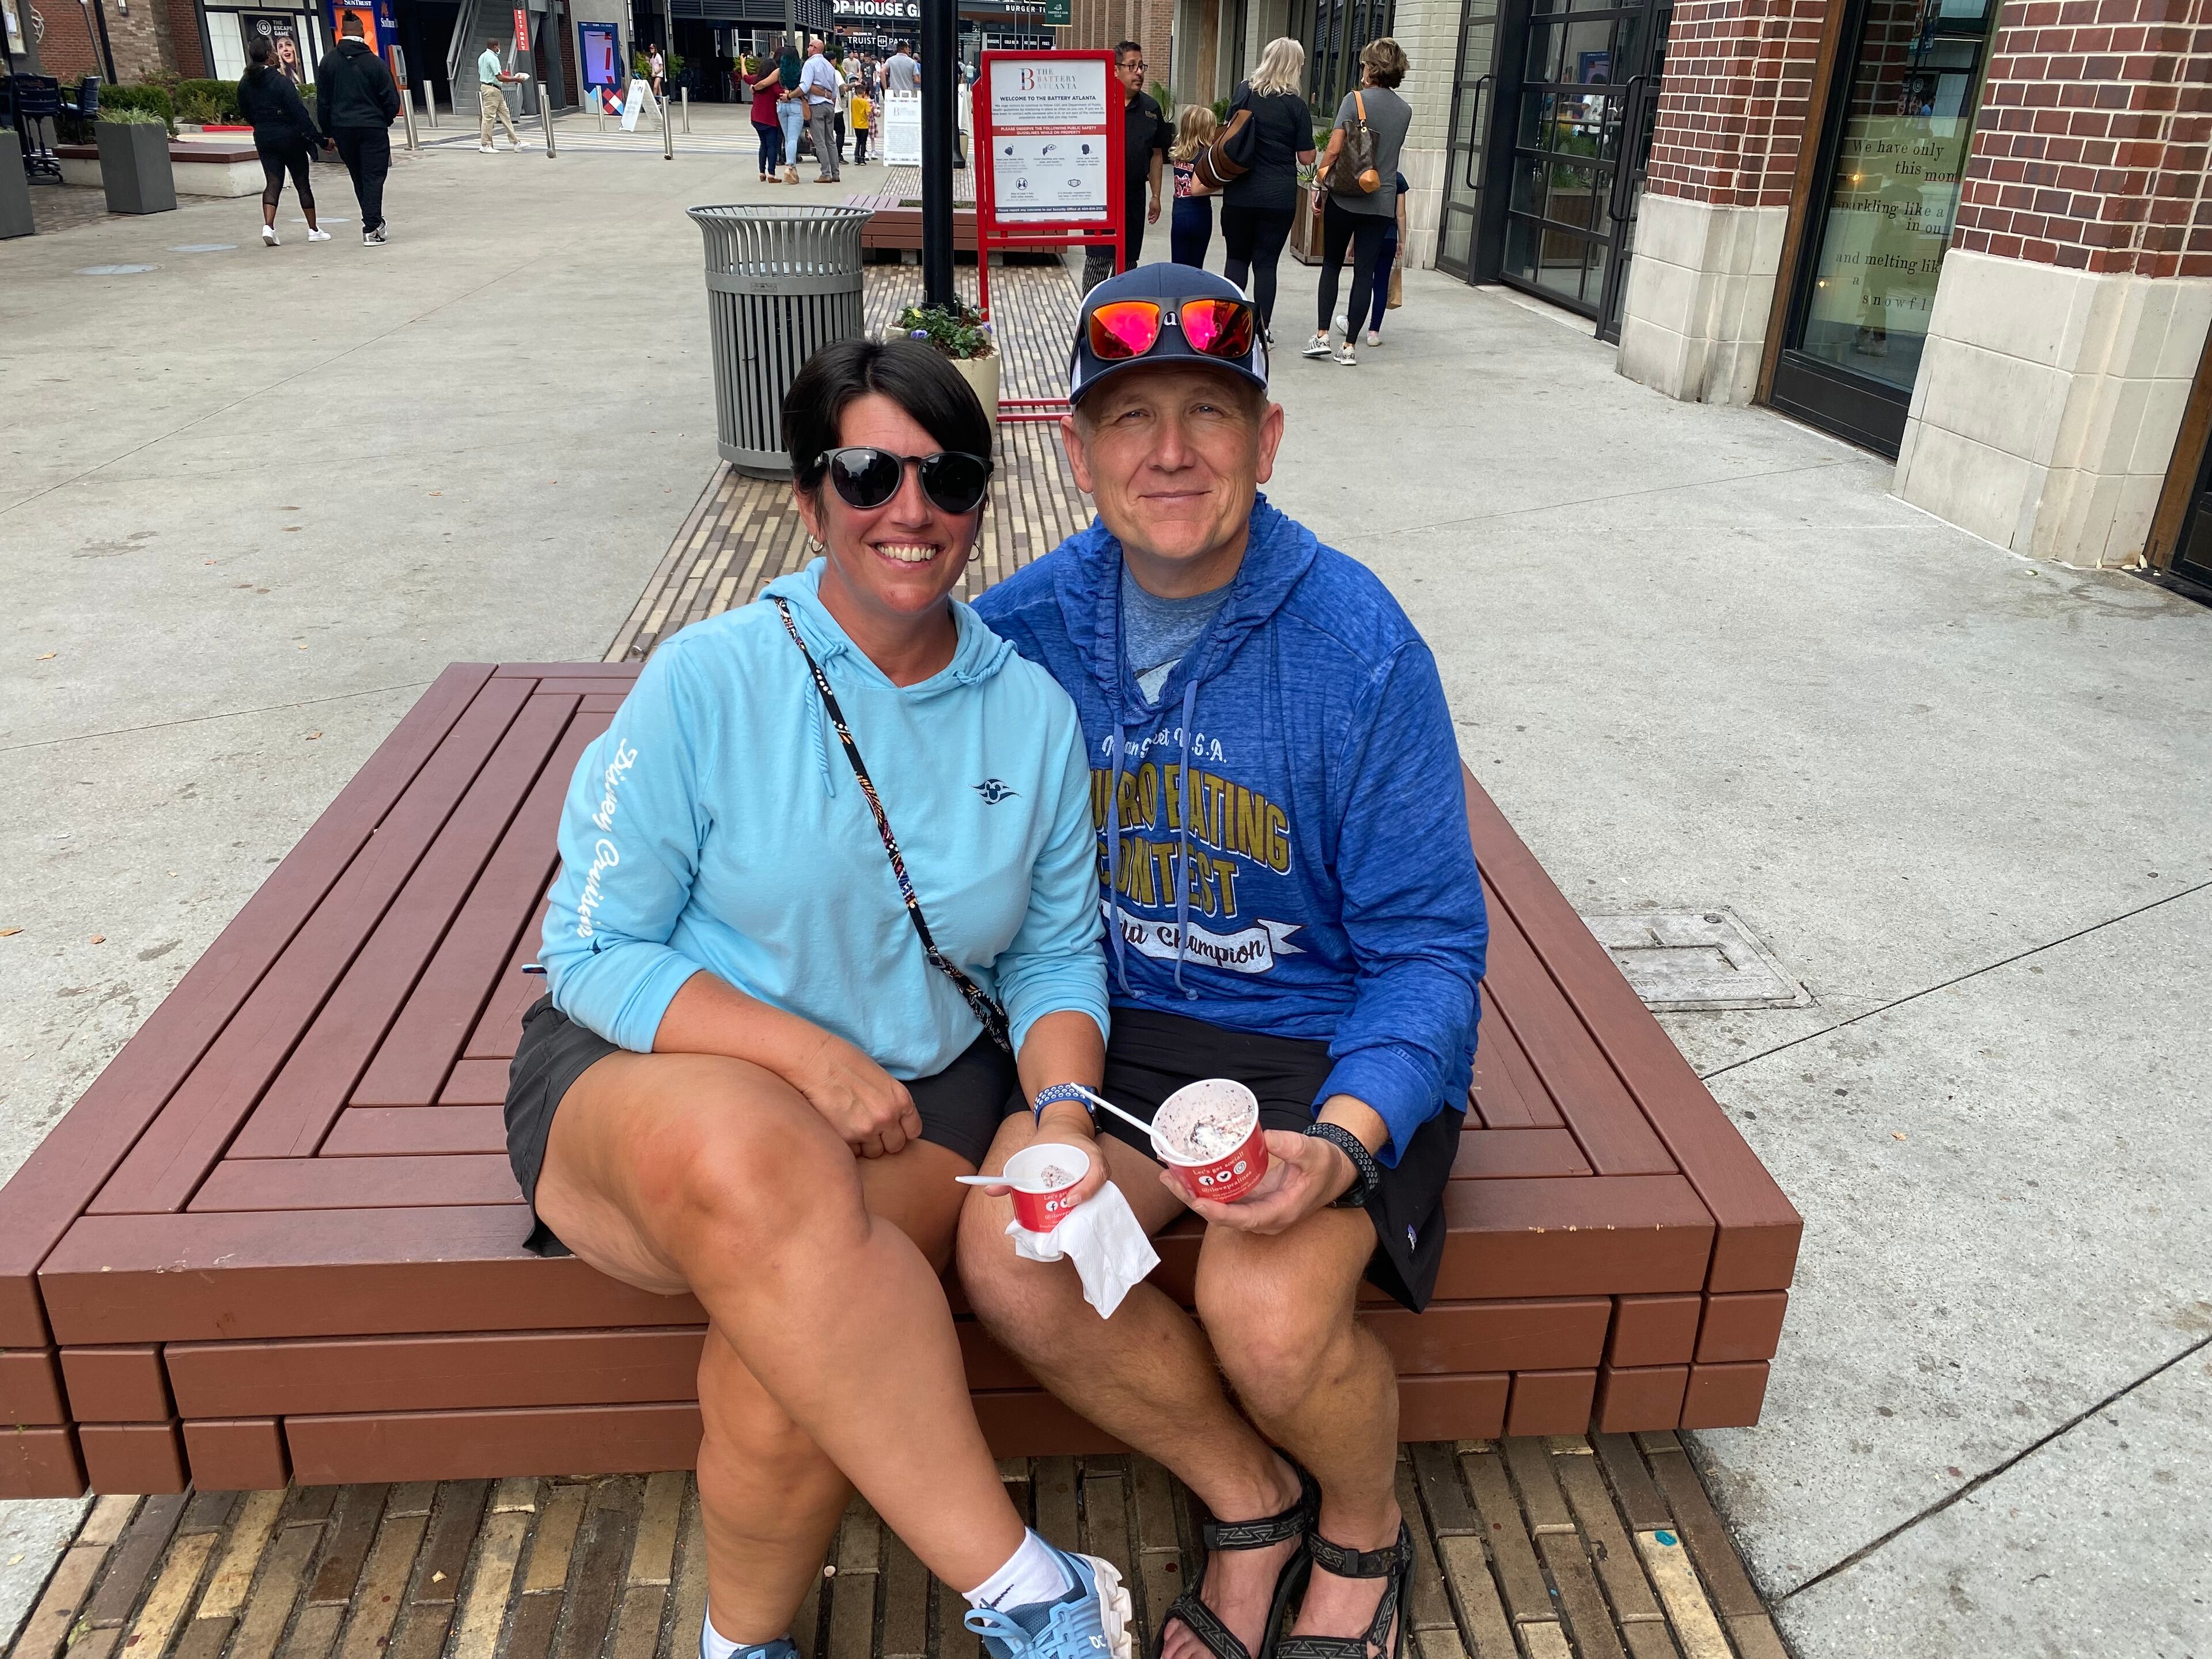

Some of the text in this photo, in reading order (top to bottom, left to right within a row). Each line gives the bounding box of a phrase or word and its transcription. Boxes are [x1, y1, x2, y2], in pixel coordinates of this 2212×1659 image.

[854, 0, 903, 17] HOUSE
[907, 3, 921, 17] G
[1005, 5, 1036, 13] BURGER
[518, 31, 527, 51] ONLY
[847, 36, 876, 44] TRUIST
[1853, 139, 1945, 161] We have only
[1895, 160, 1922, 175] this
[1834, 199, 1944, 219] sparkling like a
[1906, 217, 1921, 232] in
[1925, 224, 1946, 234] ou
[1836, 252, 1860, 264] and
[1864, 254, 1918, 275] melting
[1852, 276, 1860, 286] a
[592, 737, 638, 832] Disney
[1163, 764, 1291, 876] EATING
[1097, 836, 1240, 919] CONTEST
[1157, 926, 1265, 967] Champion
[1211, 1166, 1223, 1174] get
[1201, 1171, 1252, 1193] @ilovepralines
